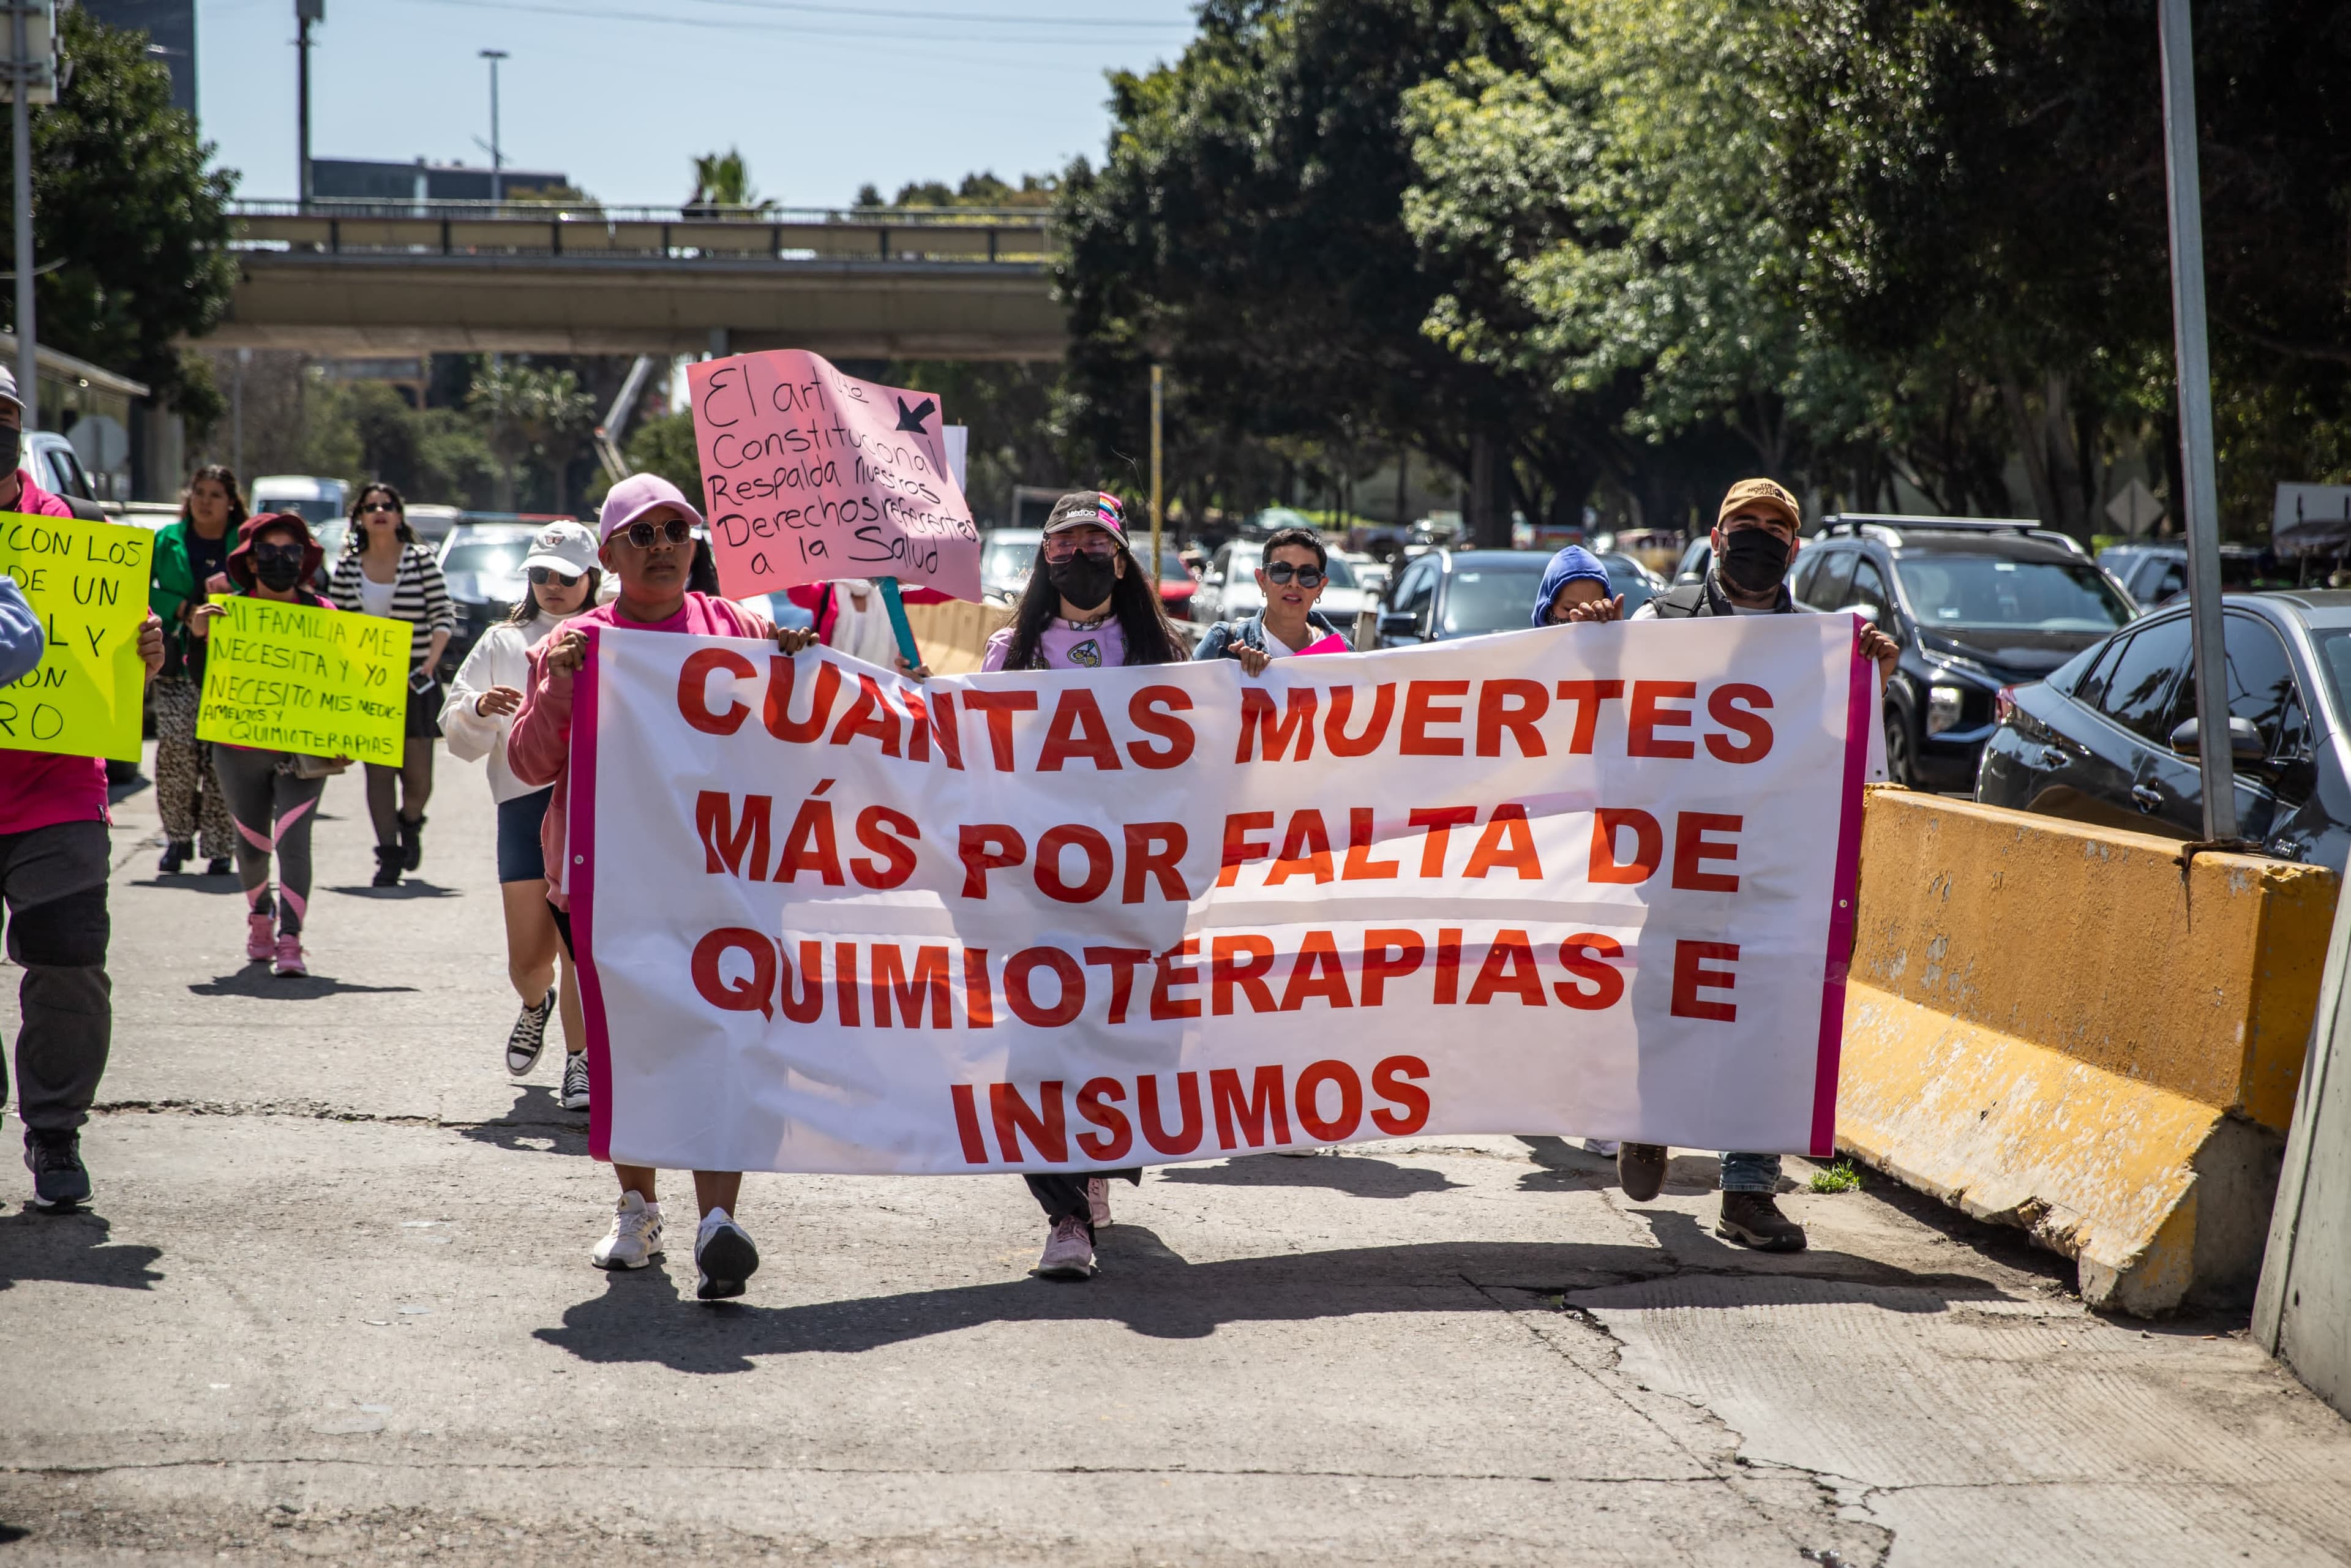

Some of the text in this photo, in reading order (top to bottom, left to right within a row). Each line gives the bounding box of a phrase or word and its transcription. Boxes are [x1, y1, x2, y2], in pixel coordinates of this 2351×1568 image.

[704, 364, 756, 427] El
[773, 366, 825, 411] art
[708, 454, 940, 511] Respalda nuestros
[8, 525, 143, 566] CON LOS
[716, 495, 977, 547] Derechos referentes
[751, 526, 938, 574] a la Salud
[7, 565, 119, 606] DE UN
[217, 602, 395, 657] MI FAMILIA ME
[10, 667, 67, 689] ON
[213, 637, 387, 686] NECESITA Y YO
[209, 675, 313, 708] NECESITO
[320, 692, 353, 712] MIS
[677, 647, 1774, 772] CUANTAS MUERTES
[229, 721, 394, 755] QUIMIOTERAPIAS
[696, 779, 1744, 904] MÁS POR FALTA DE
[690, 926, 1739, 1029] QUIMIOTERAPIAS E
[951, 1054, 1431, 1165] INSUMOS
